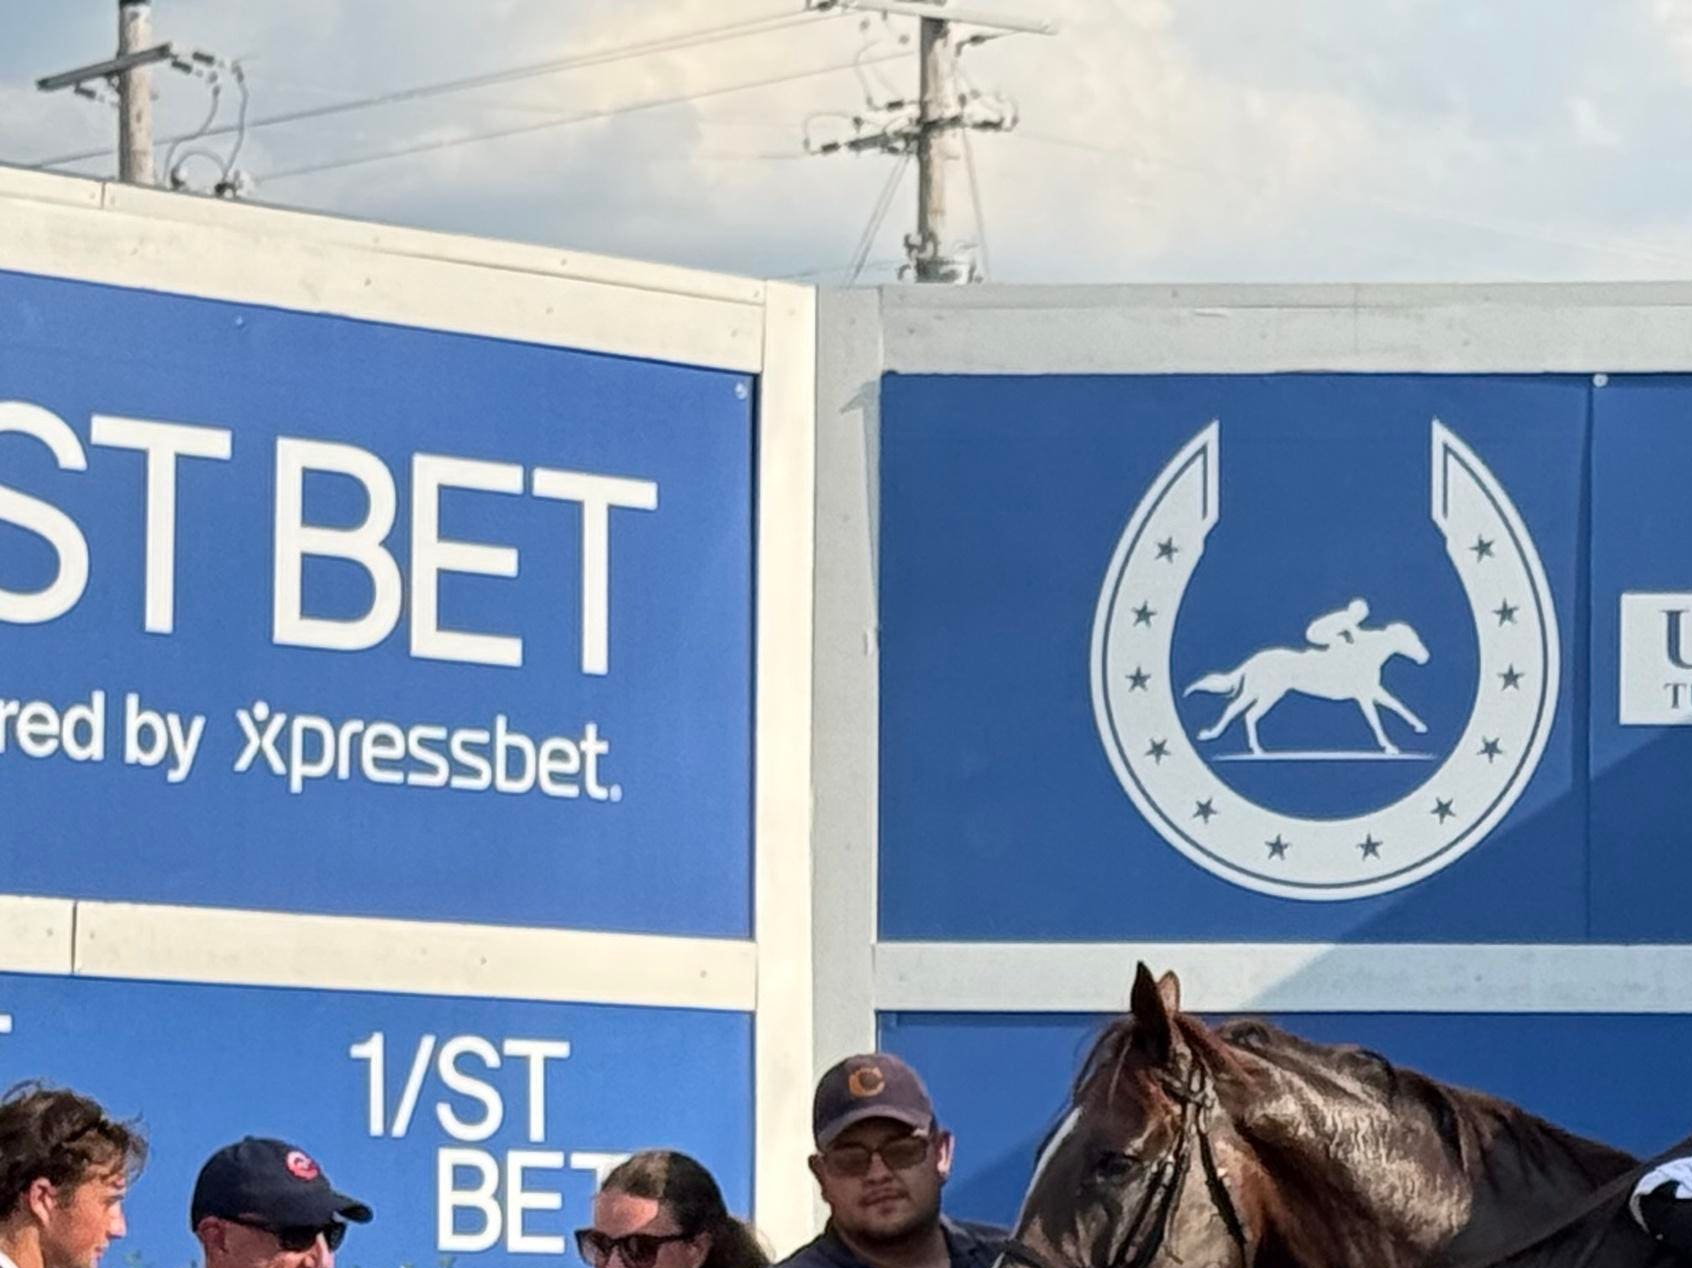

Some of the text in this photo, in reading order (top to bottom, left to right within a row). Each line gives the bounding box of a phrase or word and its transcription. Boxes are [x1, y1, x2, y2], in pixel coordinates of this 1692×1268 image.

[273, 436, 658, 675] BET
[125, 693, 206, 783] by
[350, 1032, 570, 1142] 1/ST
